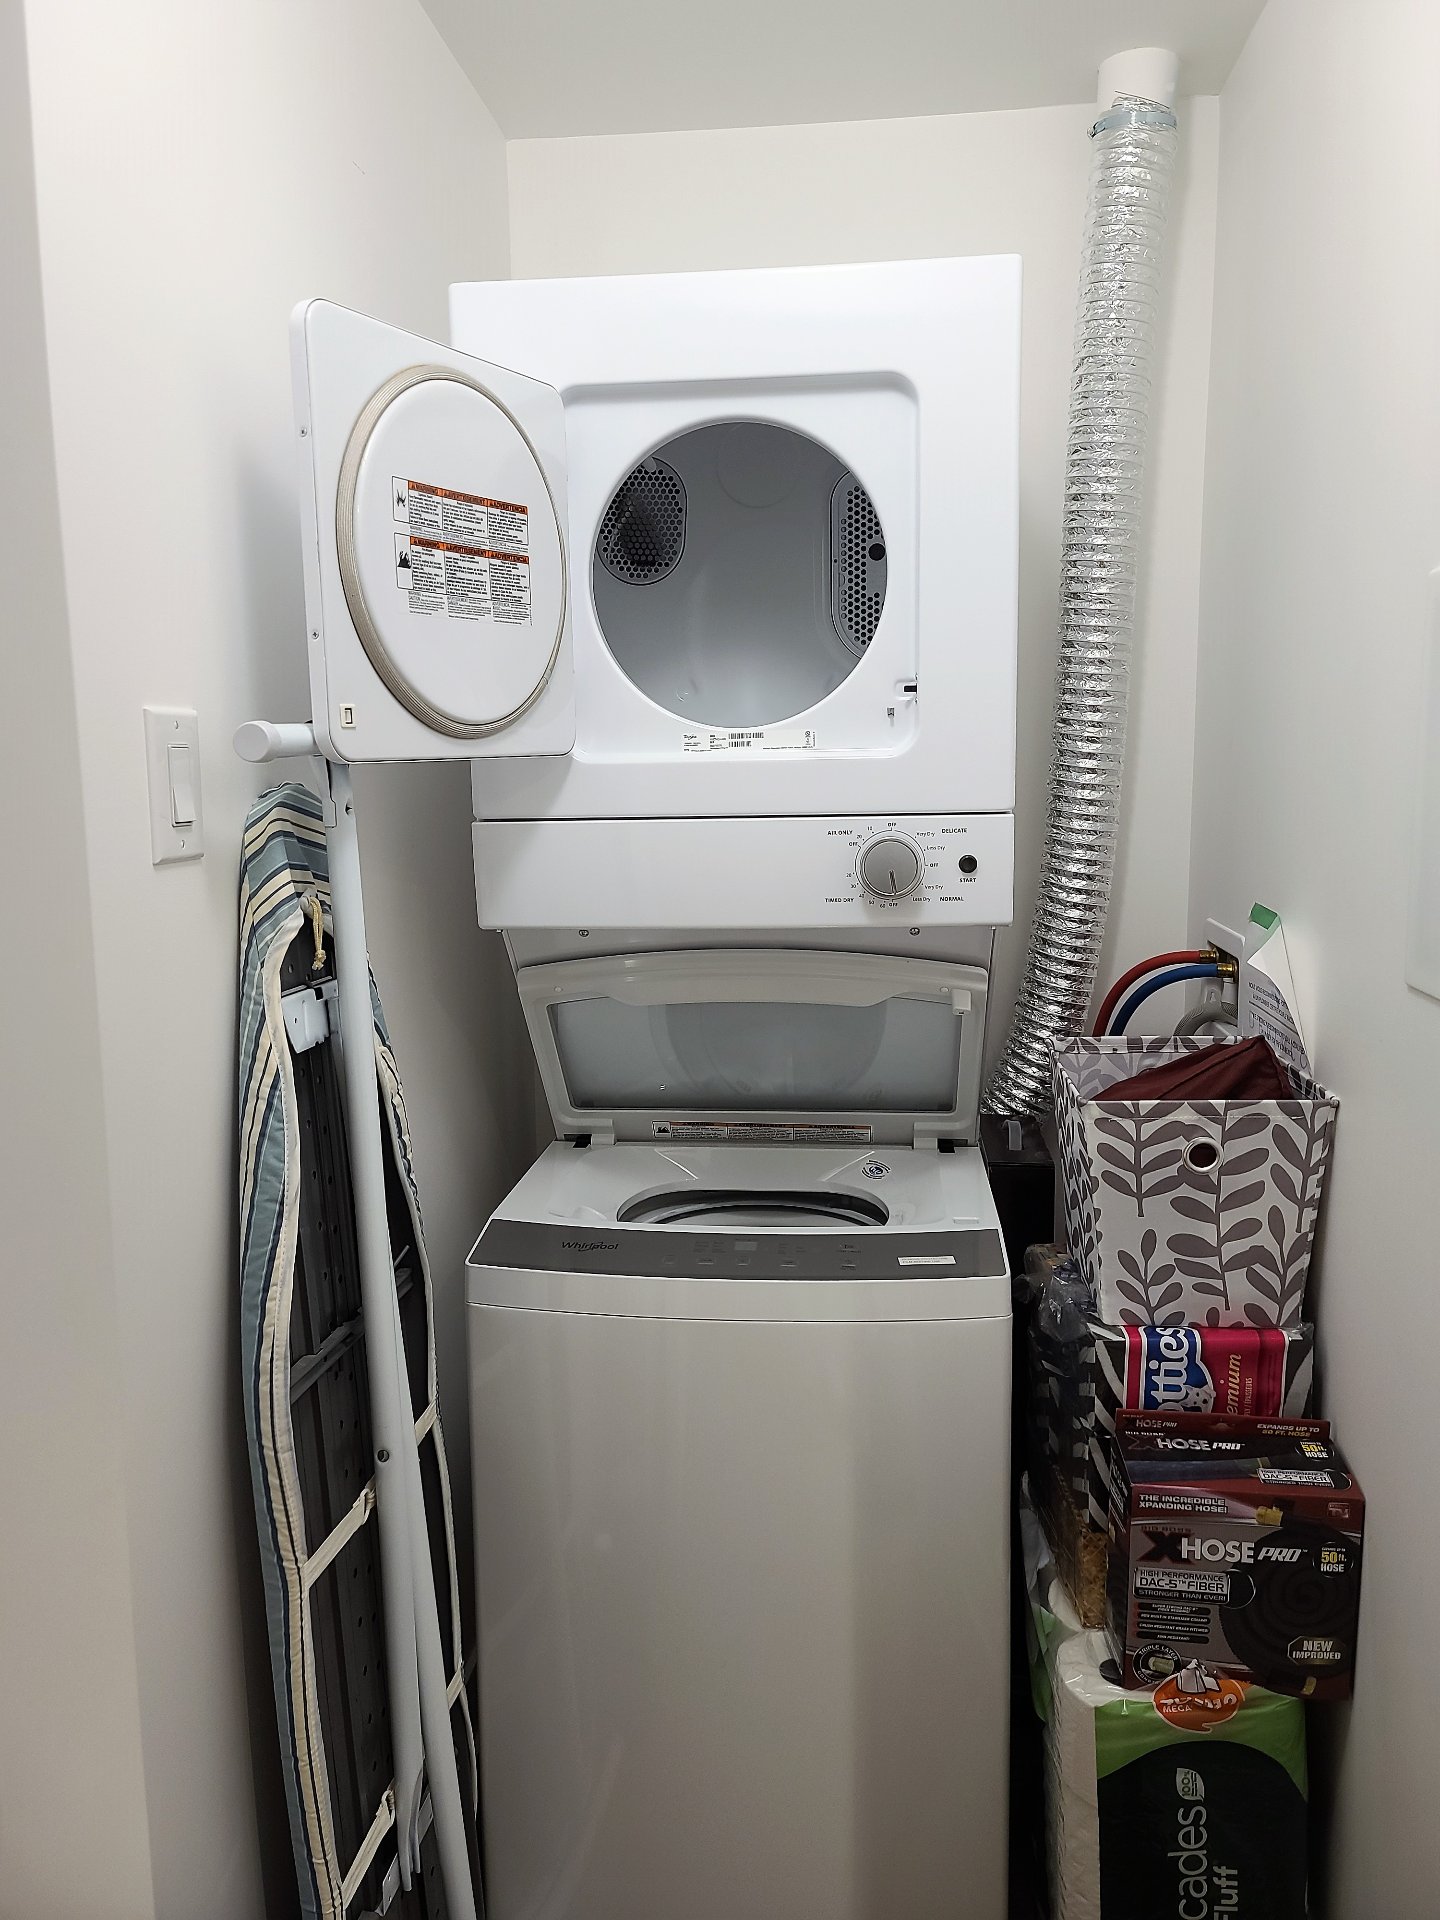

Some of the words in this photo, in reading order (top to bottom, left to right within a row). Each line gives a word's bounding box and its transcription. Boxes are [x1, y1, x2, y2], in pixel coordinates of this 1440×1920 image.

[561, 1240, 620, 1252] Whirlpool
[1256, 1423, 1294, 1432] EXPANDS
[1295, 1425, 1308, 1433] UP
[1304, 1451, 1329, 1459] HOSE
[1139, 1494, 1160, 1502] THE
[1162, 1495, 1225, 1506] INCREDIBLE
[1139, 1501, 1193, 1511] XPANDING
[1195, 1505, 1228, 1514] HOSE!
[1320, 1551, 1338, 1563] 50
[1320, 1563, 1345, 1573] HOSE
[1140, 1569, 1160, 1577] HIGH
[1161, 1570, 1224, 1582] PERFORMANCE
[1187, 1580, 1225, 1592] FIBER
[1138, 1588, 1180, 1599] STRONGER
[1182, 1591, 1202, 1600] THAN
[1203, 1593, 1226, 1602] EVER!
[1303, 1640, 1334, 1652] NEW
[1138, 1644, 1160, 1656] TRIPLE
[1161, 1645, 1178, 1661] LAYER
[1292, 1651, 1342, 1661] IMPROVED
